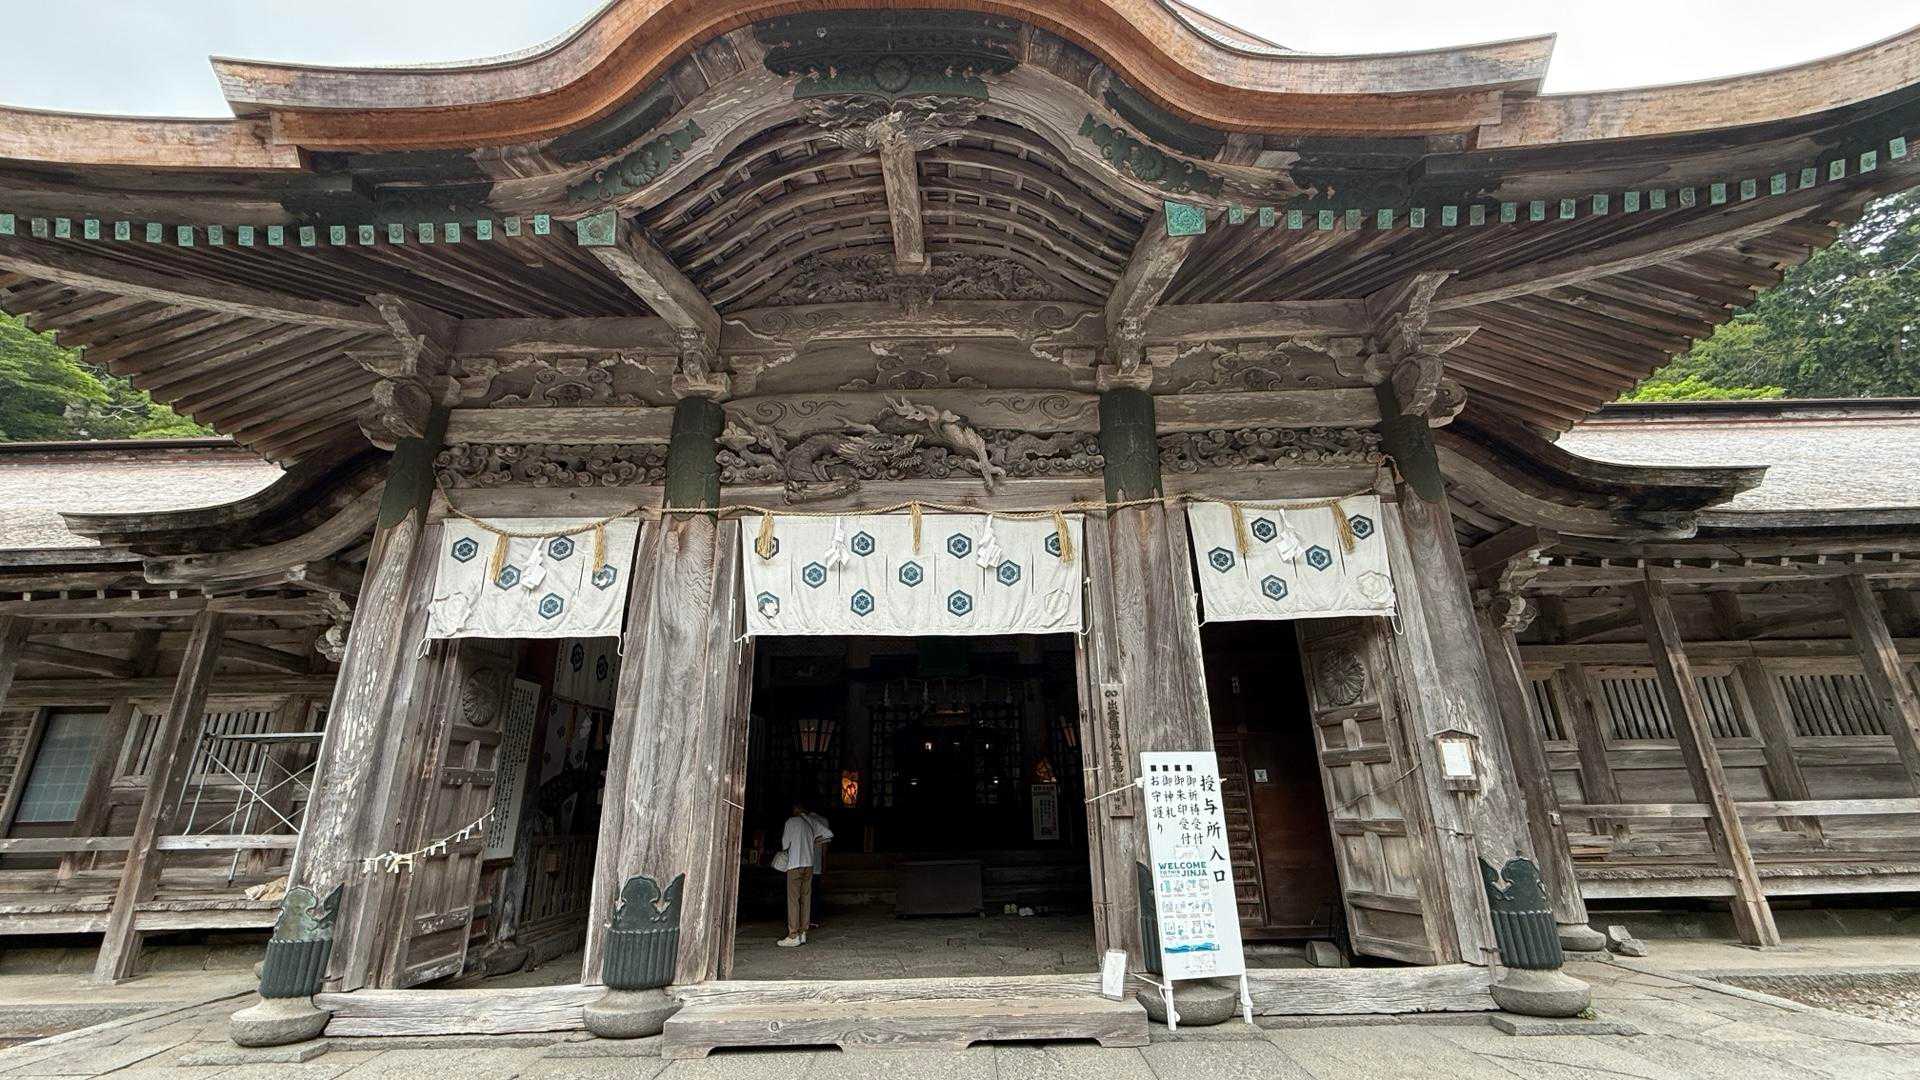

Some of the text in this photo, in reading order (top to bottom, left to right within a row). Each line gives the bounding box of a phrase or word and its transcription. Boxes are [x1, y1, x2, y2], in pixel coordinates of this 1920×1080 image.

[1162, 775, 1177, 818] 御神札
[1174, 775, 1191, 845] 御朱印受付
[1200, 775, 1226, 882] 授与所入口
[1158, 861, 1207, 870] WELCOME
[1181, 869, 1208, 877] JINJA
